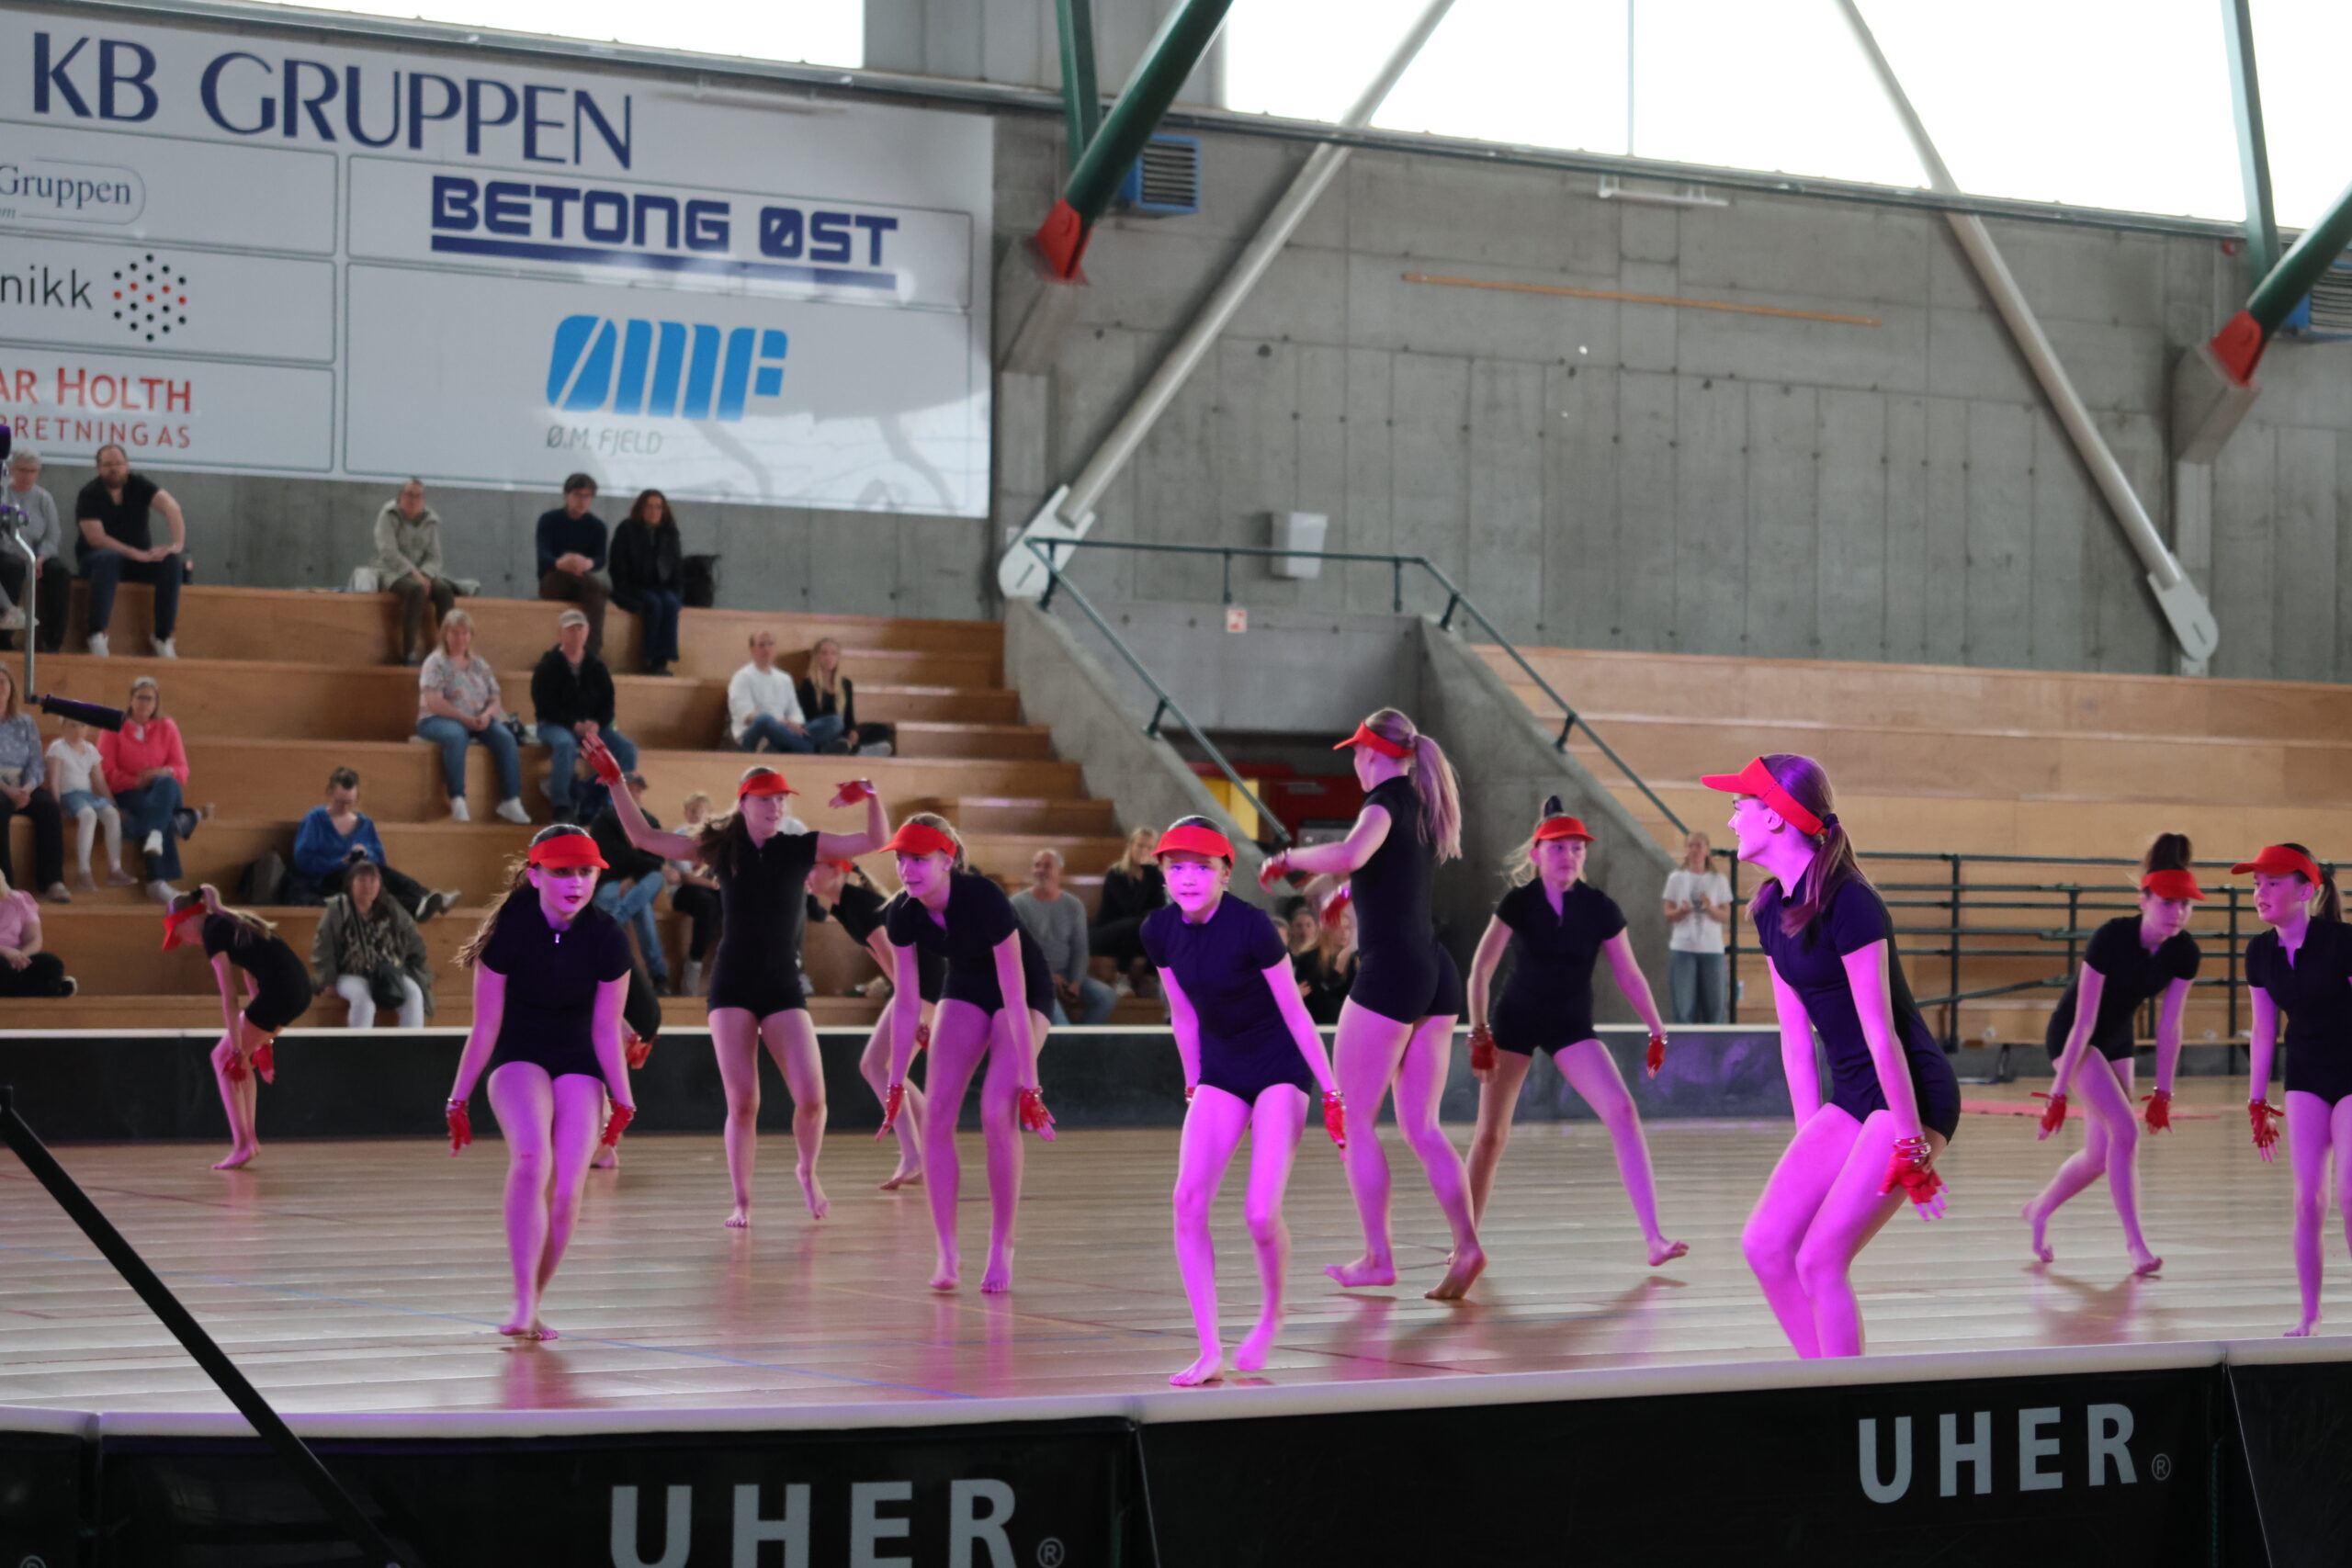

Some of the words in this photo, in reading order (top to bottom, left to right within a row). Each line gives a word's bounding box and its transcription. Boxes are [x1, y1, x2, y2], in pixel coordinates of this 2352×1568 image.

[33, 31, 159, 123] KB
[199, 51, 632, 170] GRUPPEN
[0, 164, 130, 209] Gruppen
[431, 175, 731, 254] BETONG
[759, 205, 899, 267] ØST
[57, 366, 191, 413] HOLTH
[598, 427, 664, 457] FJELD
[1859, 1403, 2139, 1504] UHER
[610, 1479, 1017, 1568] UHER
